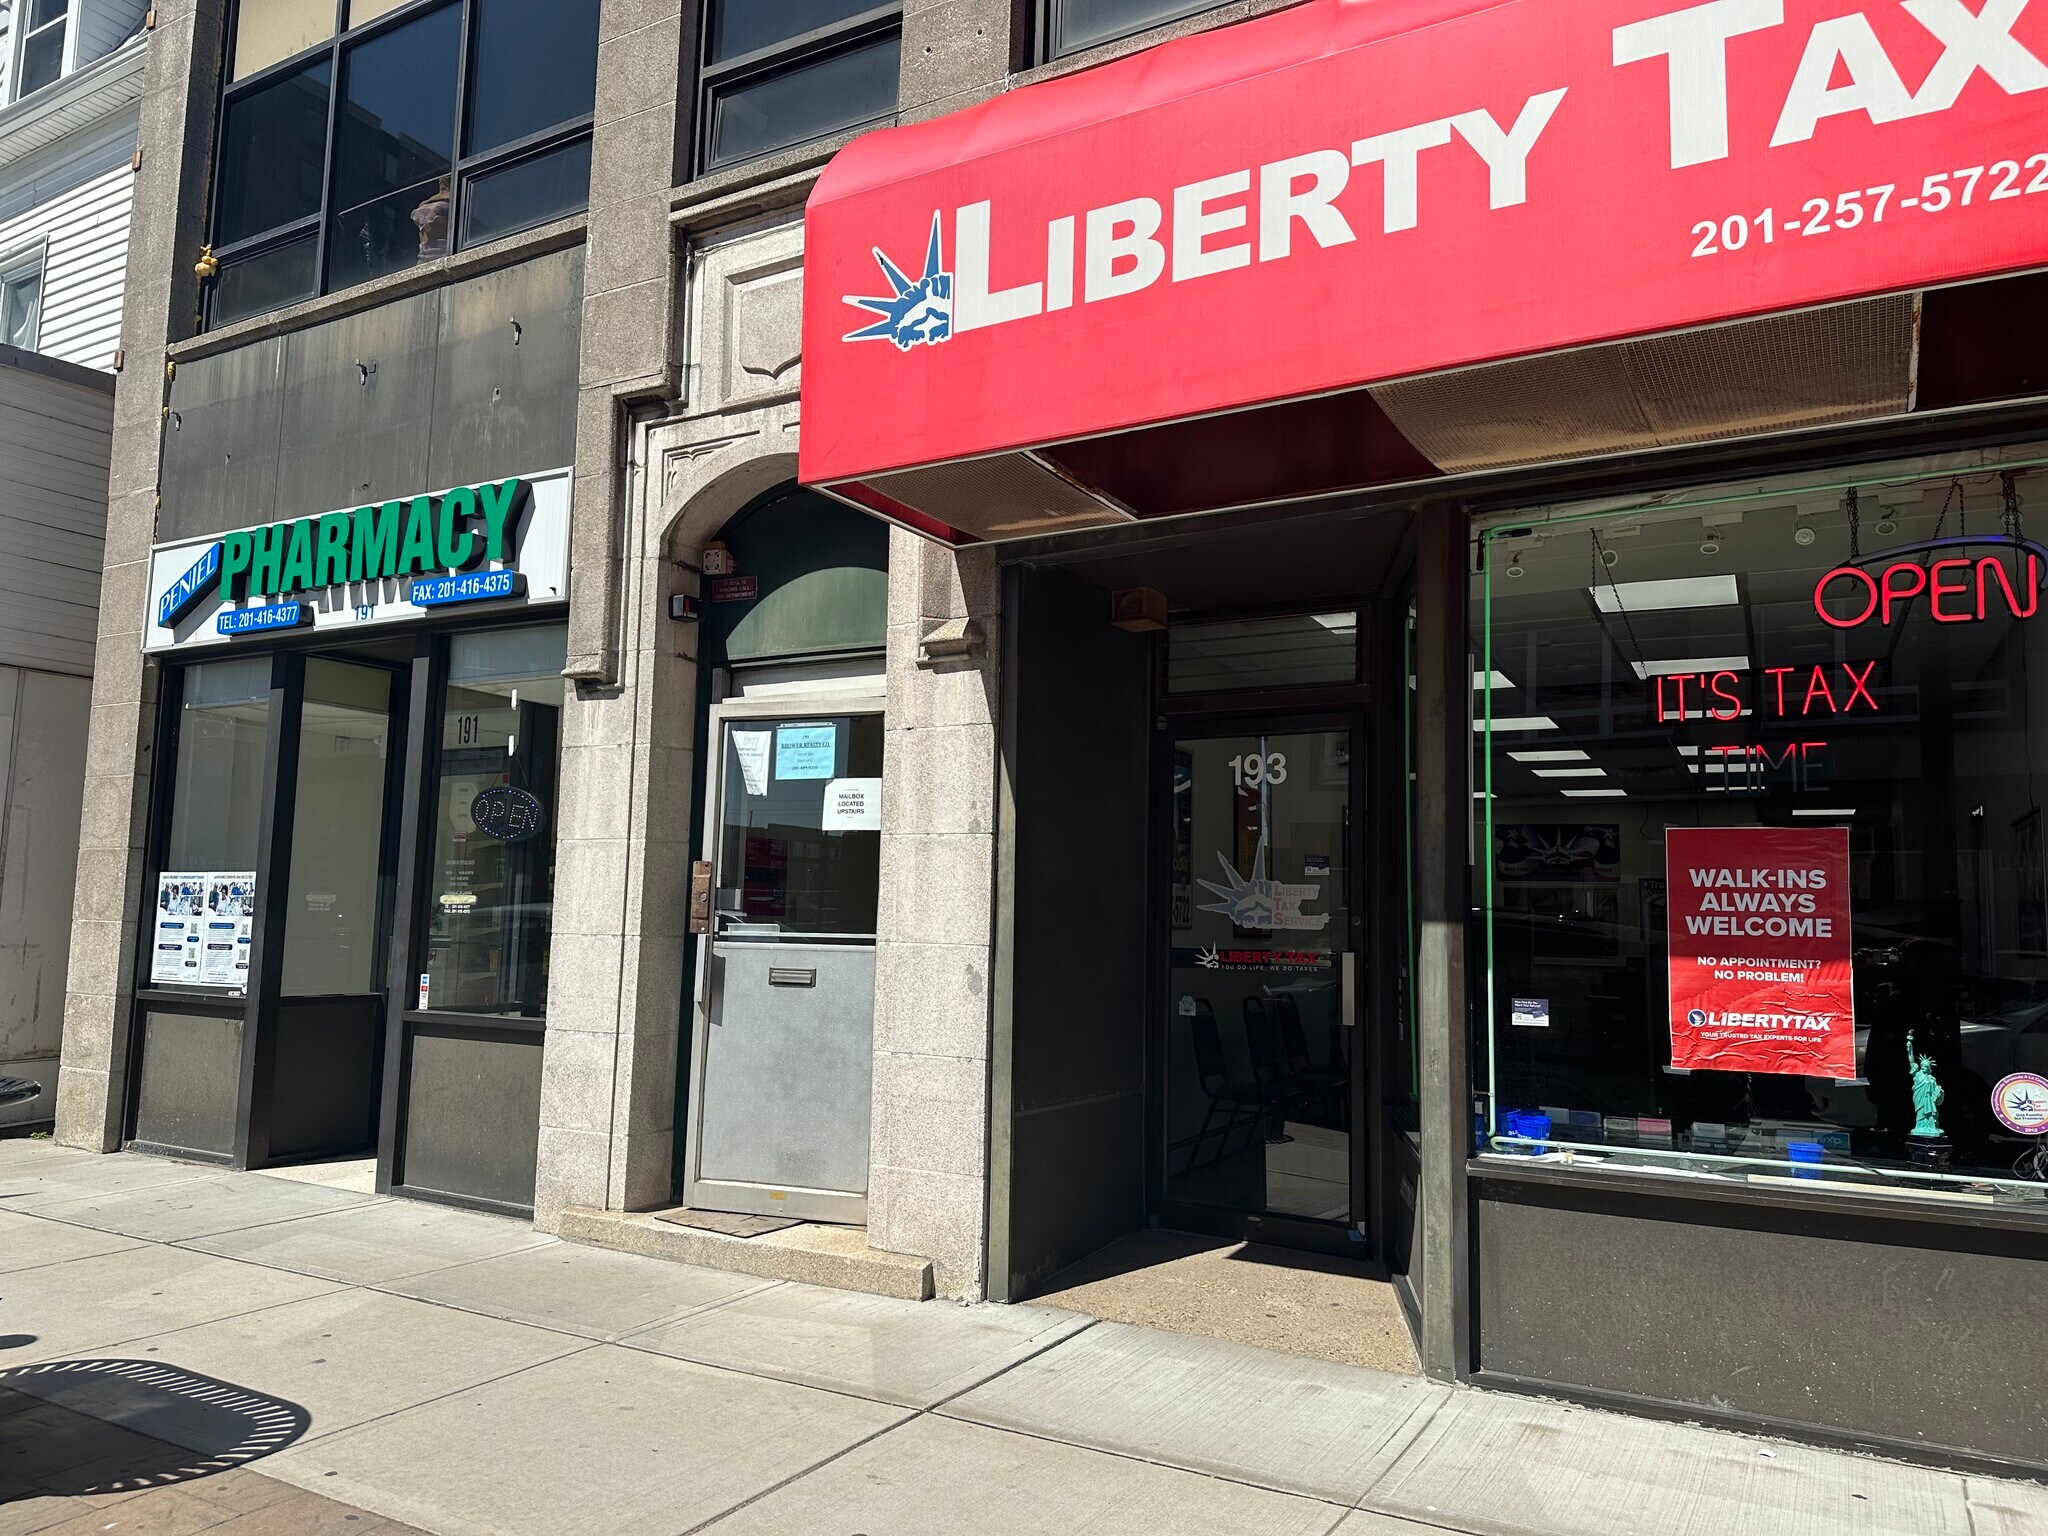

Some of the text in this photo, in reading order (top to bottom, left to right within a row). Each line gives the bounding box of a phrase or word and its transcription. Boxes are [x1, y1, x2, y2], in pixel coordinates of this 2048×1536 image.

[953, 0, 2048, 334] LIBERTY TAX
[1690, 152, 2048, 258] 201-257-5722
[219, 478, 520, 602] PHARMACY
[159, 550, 216, 623] PENIEL
[412, 573, 511, 602] FAX: 201-416-4375
[1812, 553, 2039, 630] OPEN
[218, 605, 299, 631] TEL: 201-416-4377
[354, 602, 376, 621] 191
[1656, 660, 1879, 723] IT'S TAX
[457, 714, 479, 745] 191
[1228, 752, 1288, 786] 193
[1711, 741, 1830, 793] TIME
[475, 798, 539, 832] OPEN
[1688, 868, 1828, 889] WALK-INS
[1274, 885, 1320, 898] LIBERTY
[1699, 892, 1817, 914] ALWAYS
[1274, 897, 1297, 911] TAX
[1274, 912, 1323, 927] SERVICE
[1684, 915, 1833, 938] WELCOME
[1220, 950, 1318, 965] LIBERTY TAX
[1697, 956, 1822, 970] NO APPOINTMENT?
[1714, 970, 1805, 983] NO PROBLEM!
[1708, 1011, 1832, 1031] LIBERTYTAX
[1700, 1031, 1719, 1039] YOUR
[1719, 1032, 1749, 1040] TRUSTED
[1763, 1034, 1793, 1042] EXPERTS
